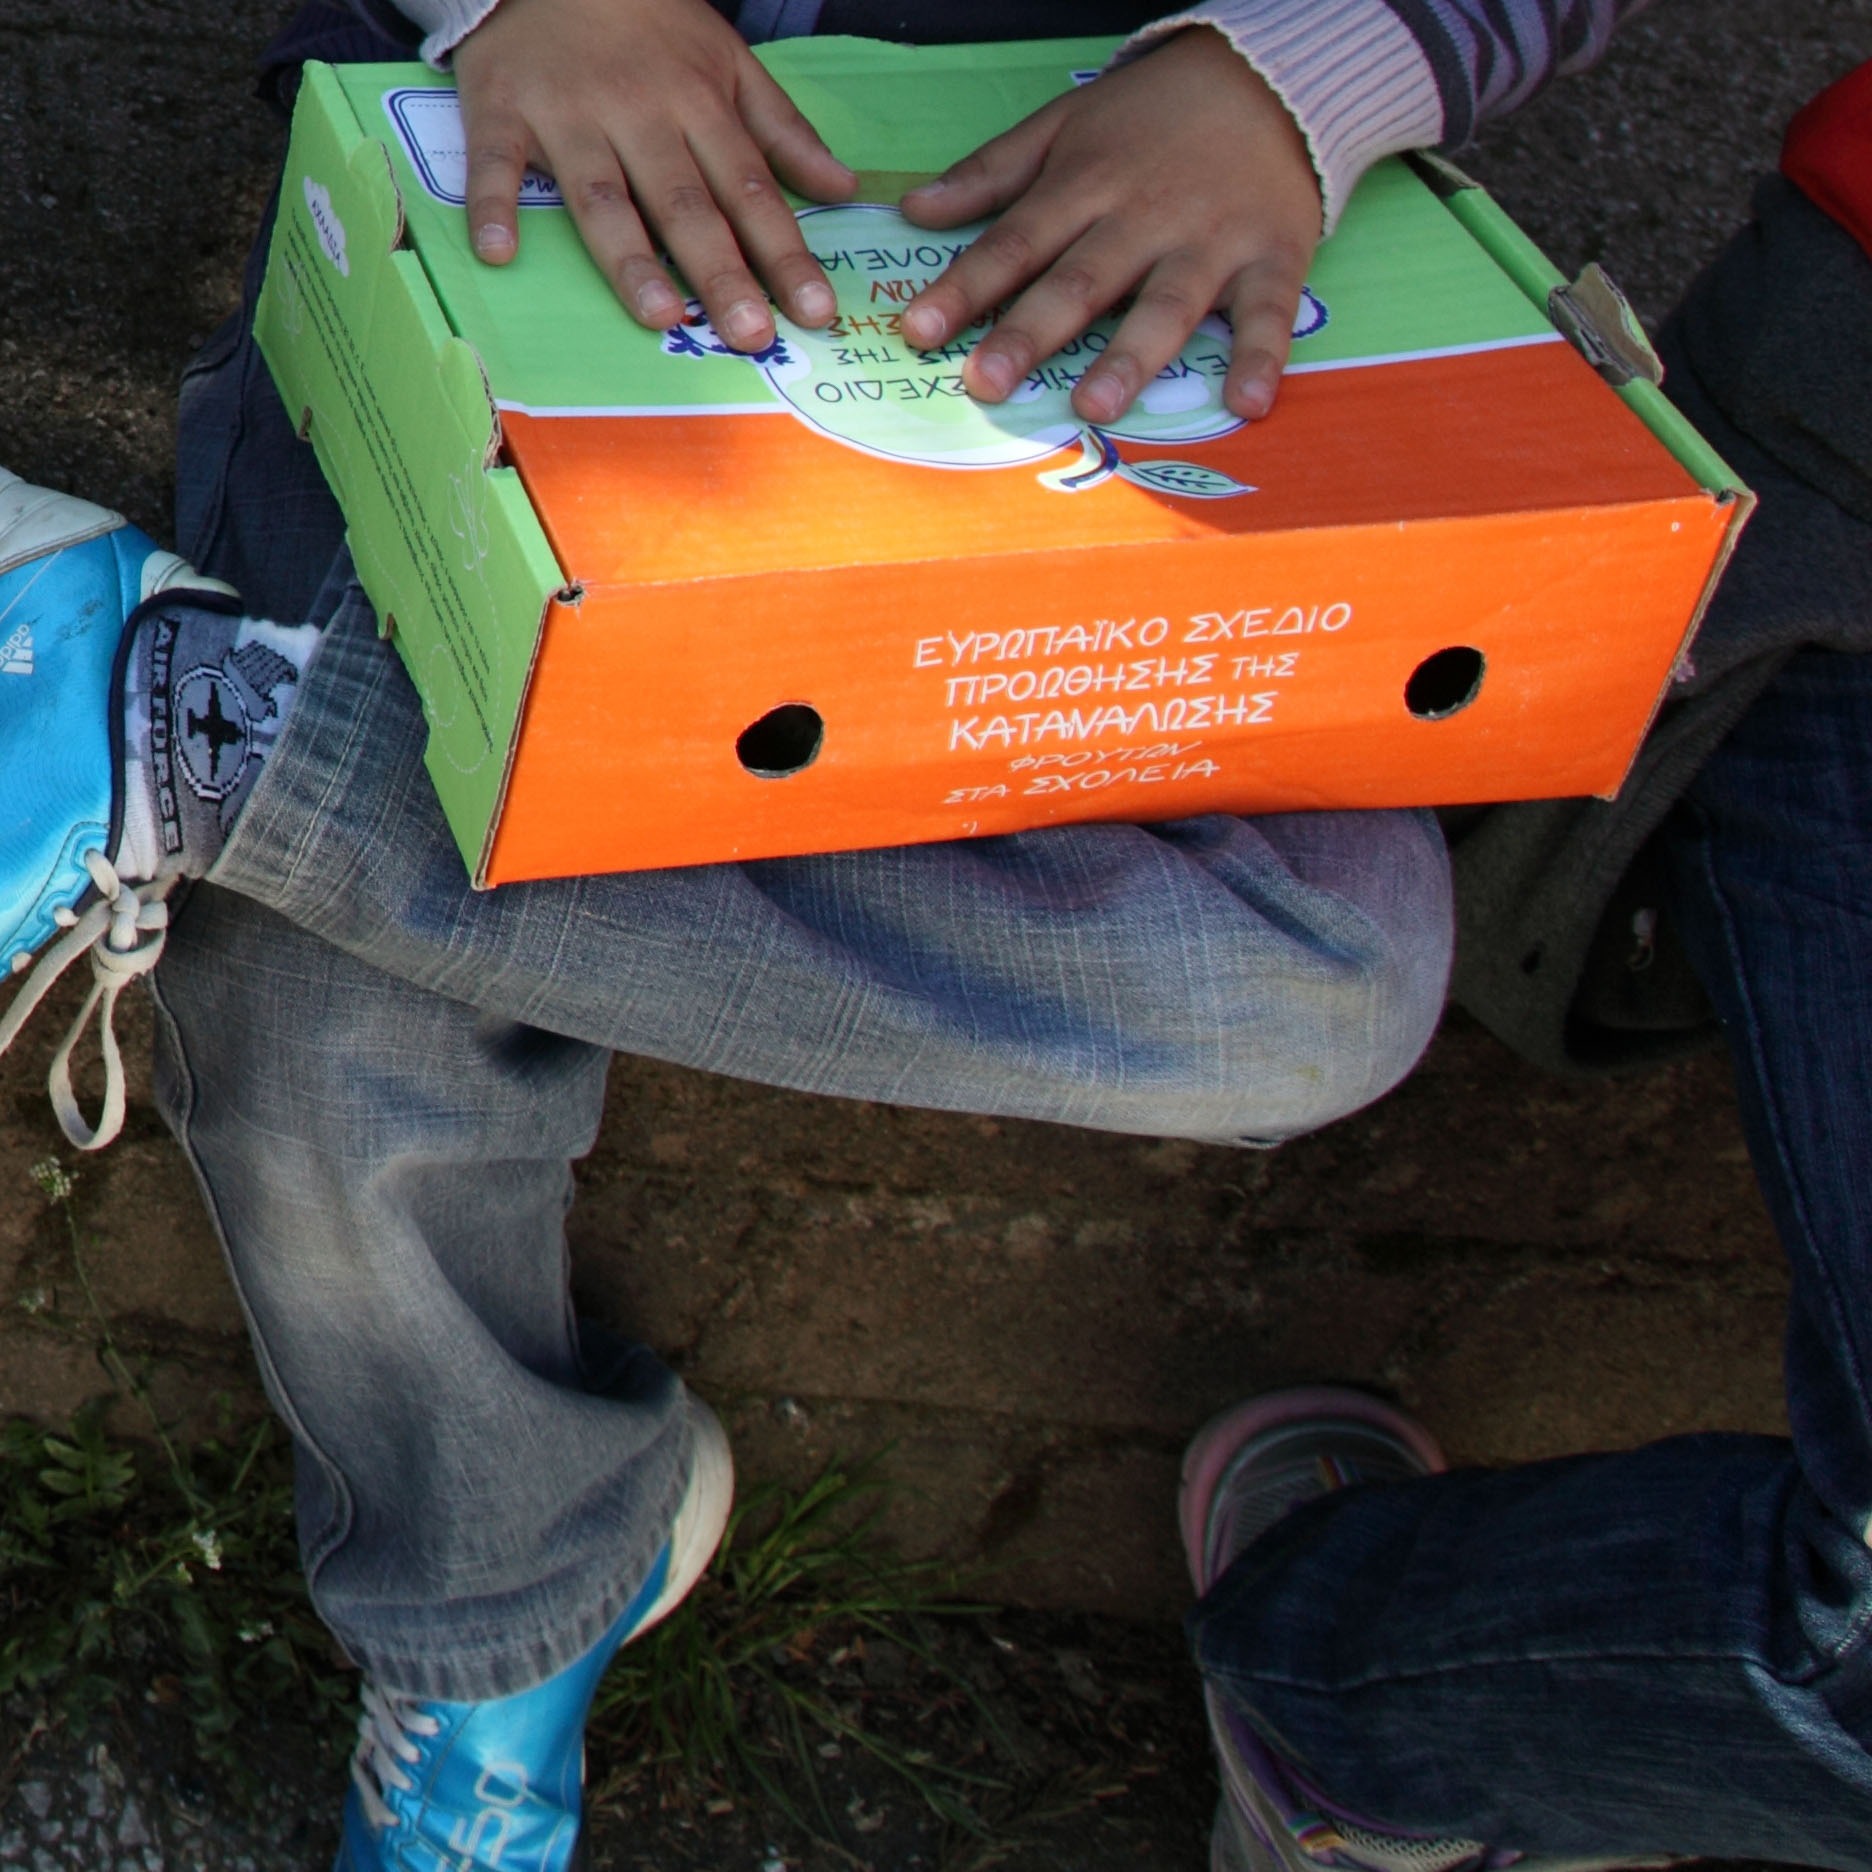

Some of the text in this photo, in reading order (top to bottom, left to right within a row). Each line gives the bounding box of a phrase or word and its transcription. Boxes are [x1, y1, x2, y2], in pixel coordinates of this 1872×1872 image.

[830, 345, 902, 367] ΤΗΣ
[912, 601, 1353, 669] ΕΥΡΩΠΑΪΚΟ ΣΧΕΔΙΟ
[944, 651, 1301, 708] ΠΡΟΩΘΗΣΗΣ ΤΗΣ
[947, 690, 1279, 752] ΚΑΤΑΝΑΛΩΣΗΣ
[943, 758, 1221, 805] ΣΤΑ ΣΧΟΛΕΙΑ
[1008, 740, 1204, 773] ΦΡΟΥΤΩΝ
